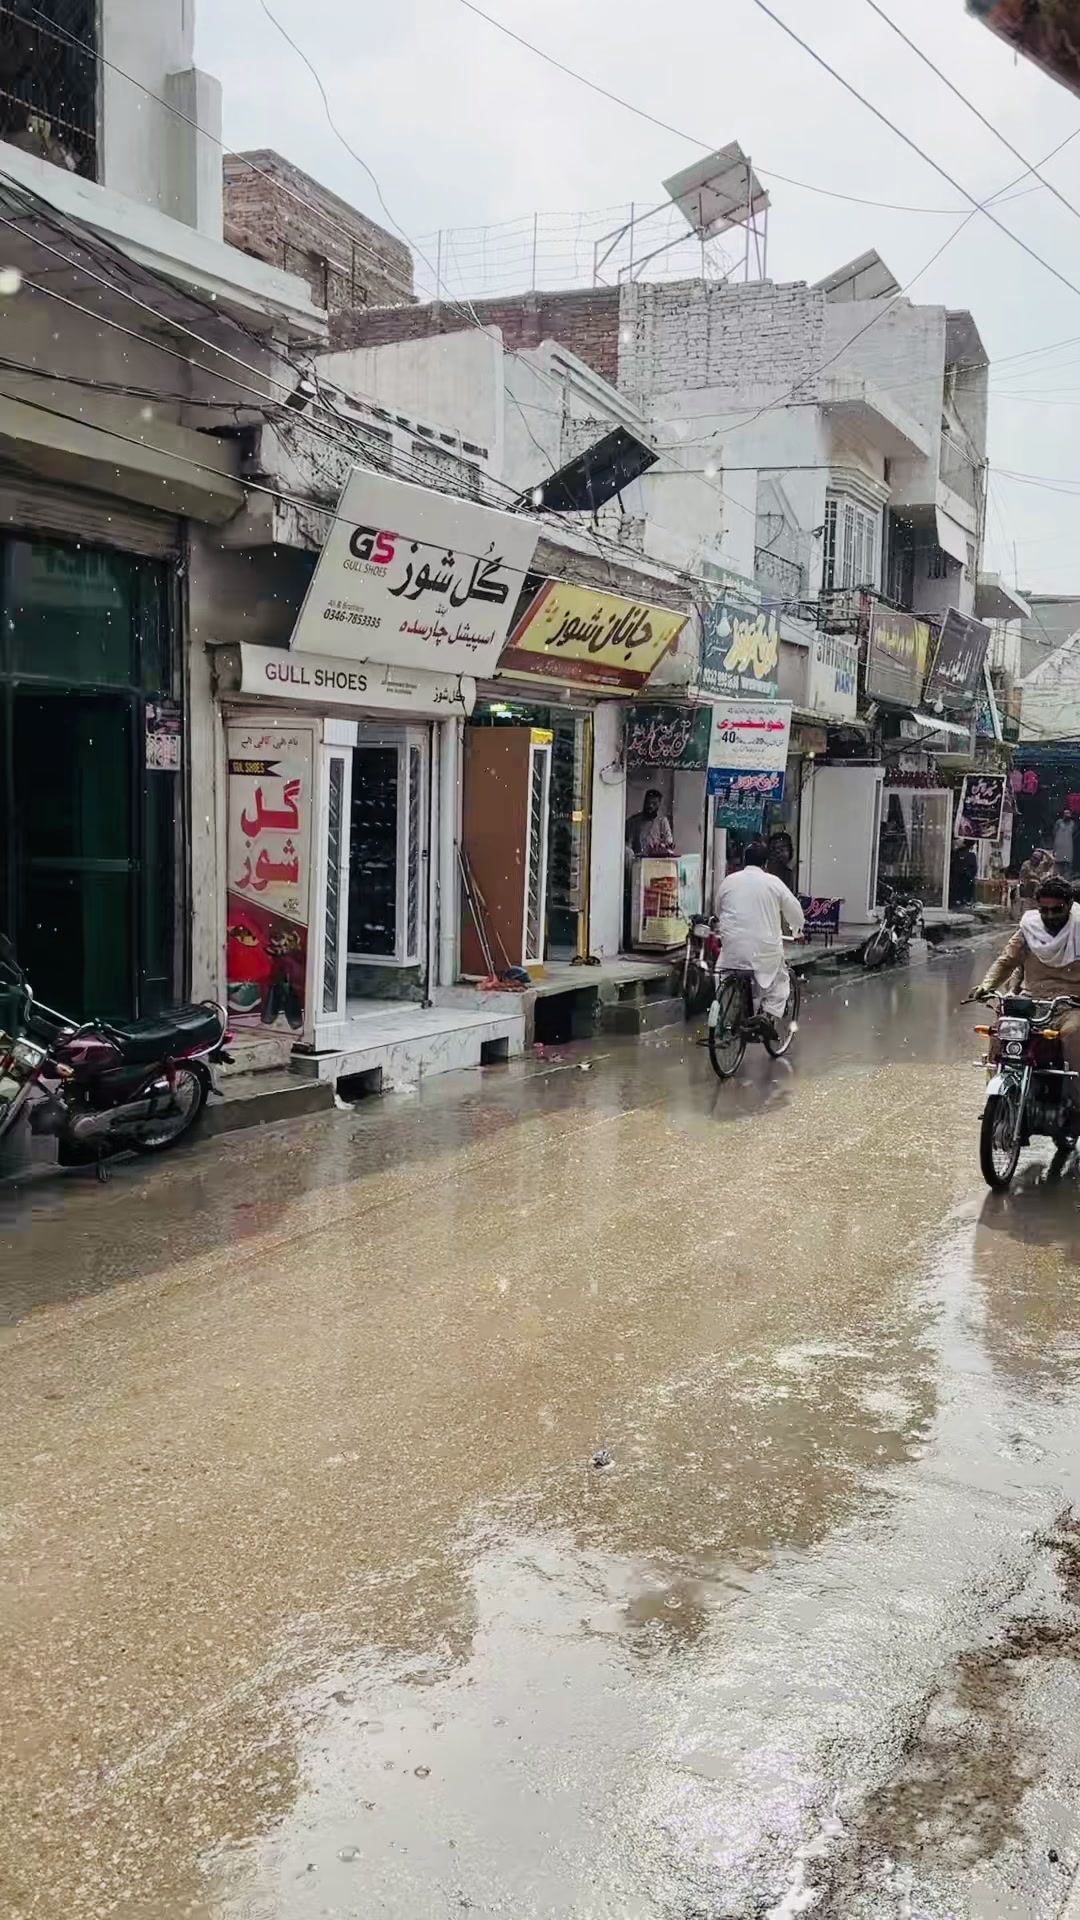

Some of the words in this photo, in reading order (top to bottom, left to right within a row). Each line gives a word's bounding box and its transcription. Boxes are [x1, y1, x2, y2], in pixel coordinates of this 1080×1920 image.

[349, 526, 396, 565] GS
[343, 559, 362, 573] GULL
[364, 564, 388, 578] SHOES
[387, 541, 456, 601] شوز
[447, 622, 496, 652] اسپیشل
[545, 607, 605, 647] شوز
[587, 606, 653, 662] جانان
[265, 662, 310, 685] GULL
[314, 669, 368, 692] SHOES
[432, 686, 449, 704] شوز
[716, 716, 785, 733] خوشخبری
[240, 779, 301, 838] گل
[234, 838, 299, 892] شوز
